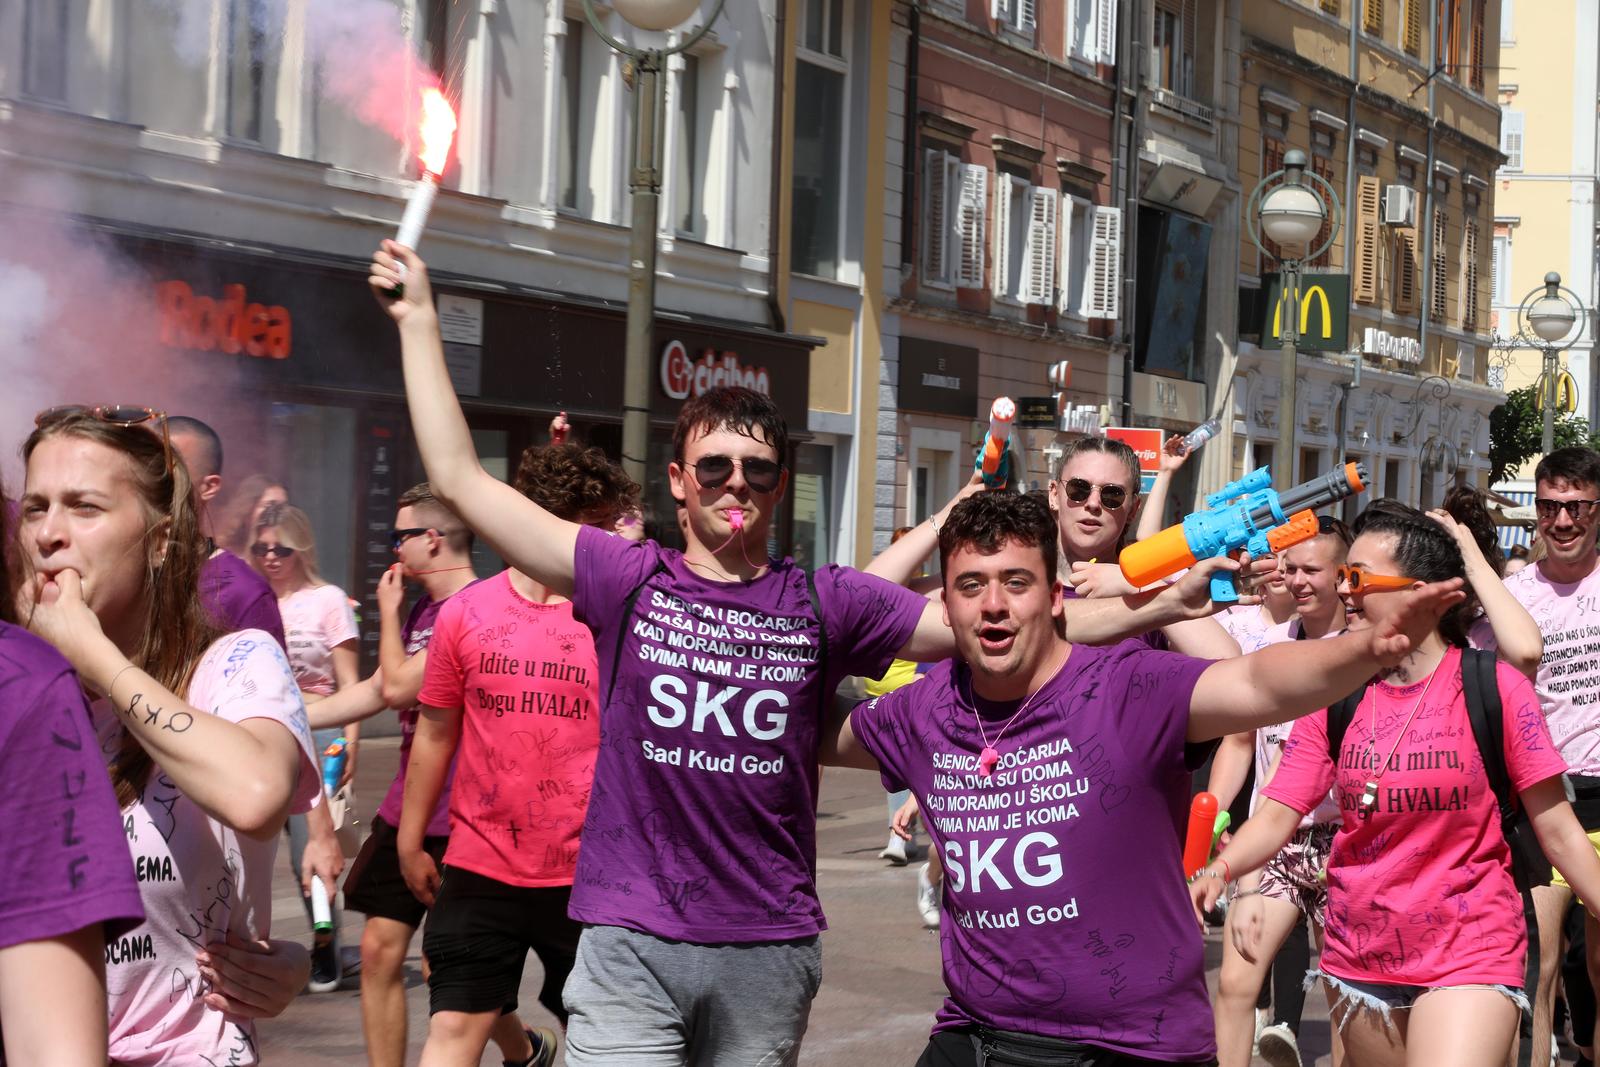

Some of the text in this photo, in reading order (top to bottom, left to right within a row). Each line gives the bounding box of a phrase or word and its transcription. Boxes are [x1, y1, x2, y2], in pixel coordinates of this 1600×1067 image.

[648, 611, 811, 646] NAŠA DVA SU DOMA
[726, 609, 808, 632] BOĆARIJA
[633, 620, 819, 663] KAD MORAMO U ŠKOLU
[479, 652, 591, 689] Idite u miru,
[638, 644, 806, 682] SVIMA NAM JE KOMA
[476, 688, 590, 721] Bogu HVALA!
[646, 674, 790, 741] SKG
[642, 740, 785, 775] Sad Kud God
[996, 738, 1073, 770] BOĆARIJA
[1341, 743, 1465, 772] Idite u miru,
[933, 760, 1073, 790] NAŠA DVA SU DOMA
[926, 777, 1090, 812] KAD MORAMO U ŠKOLU
[1385, 785, 1470, 814] HVALA!
[967, 815, 999, 833] NAM
[1003, 813, 1022, 830] JE
[1026, 803, 1080, 827] KOMA
[944, 831, 1064, 893] SKG
[976, 908, 1020, 930] Kud
[1026, 898, 1079, 925] God
